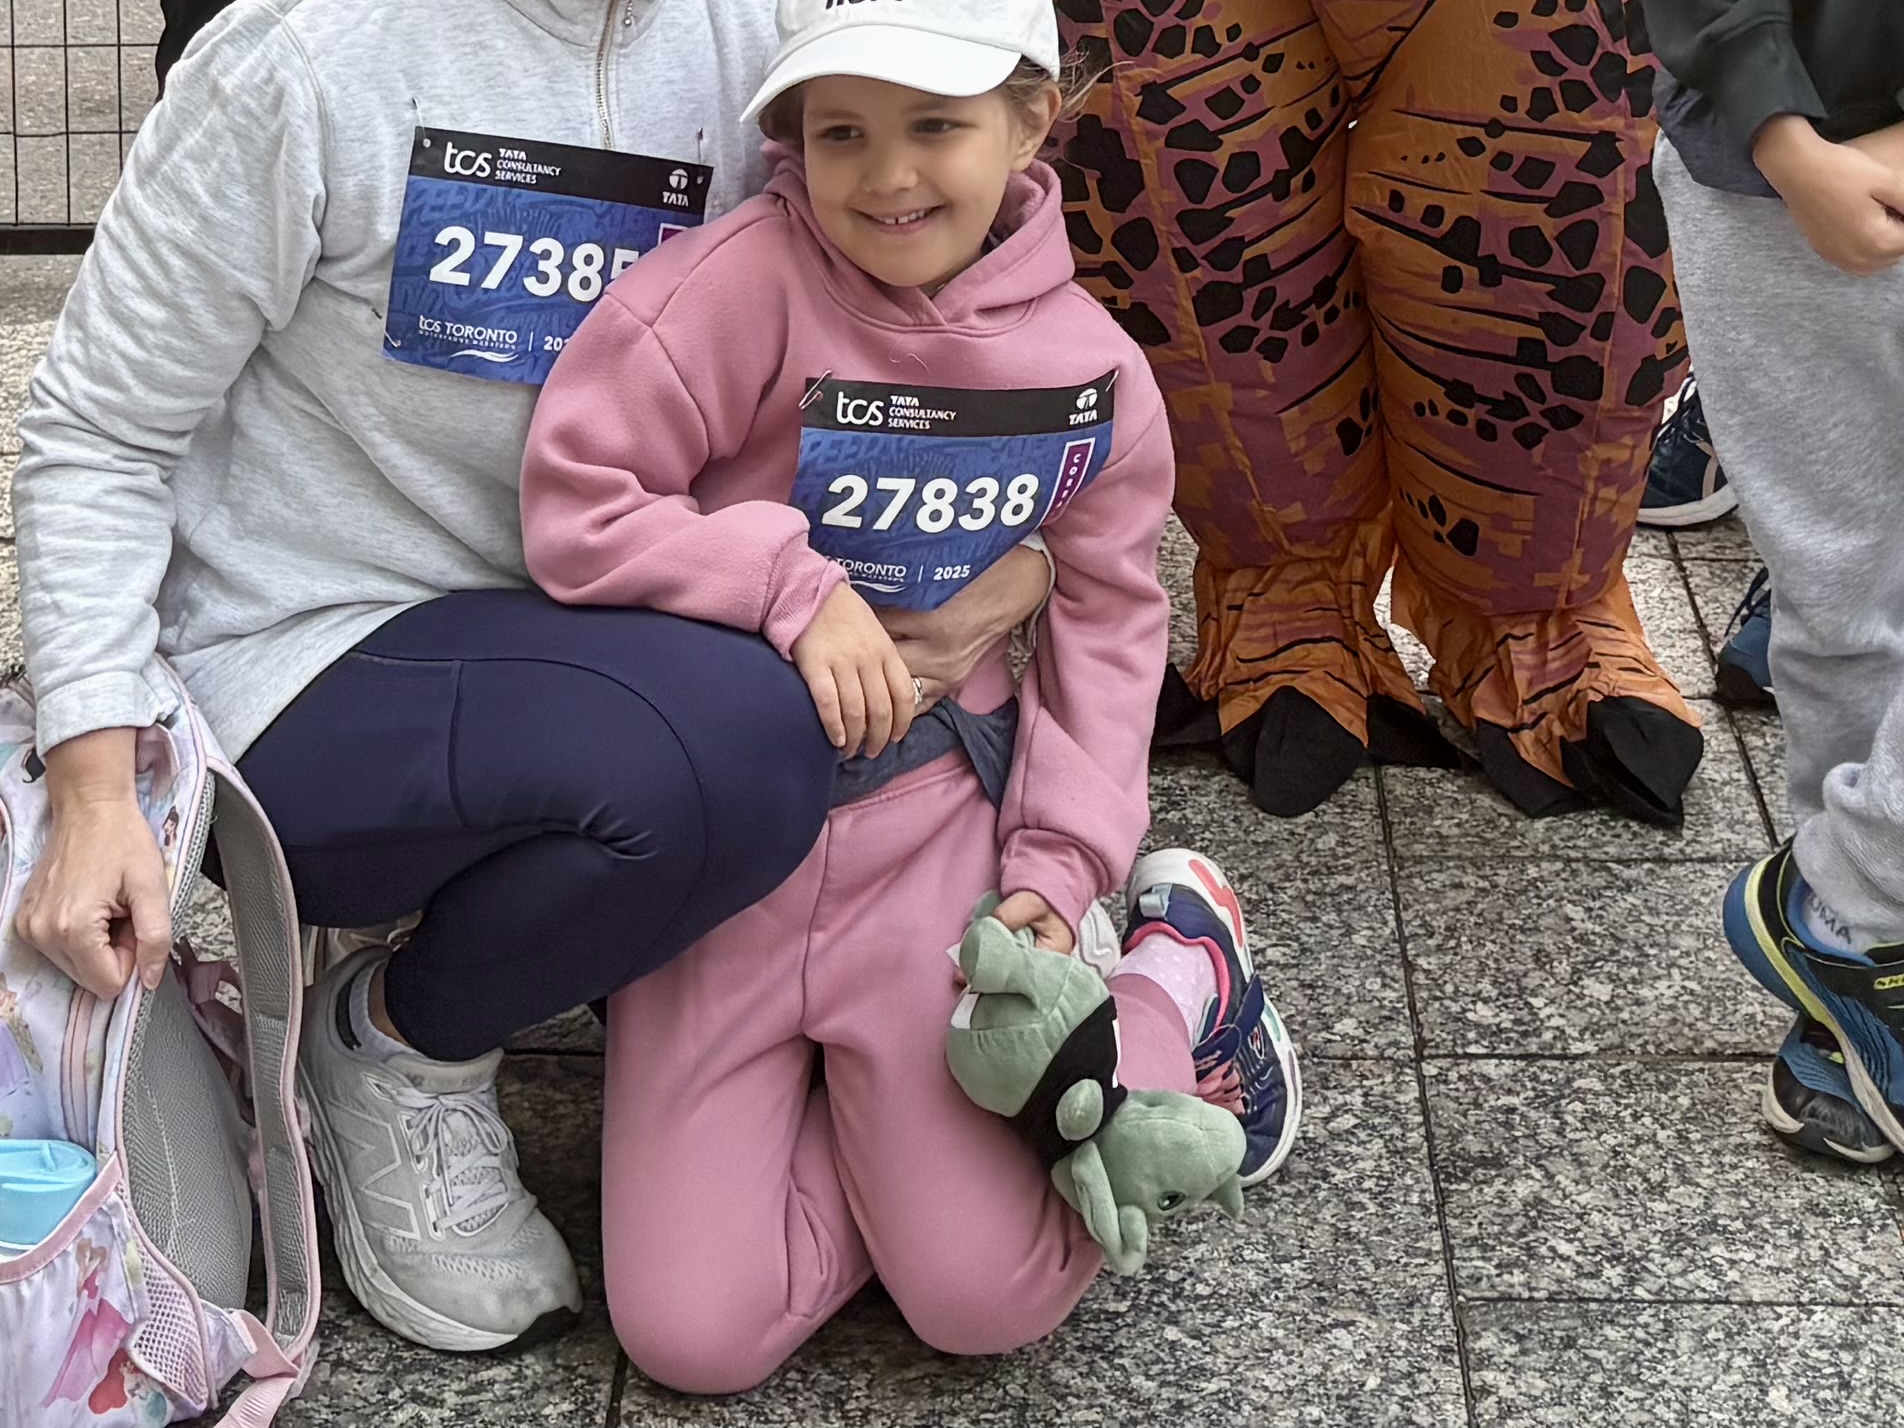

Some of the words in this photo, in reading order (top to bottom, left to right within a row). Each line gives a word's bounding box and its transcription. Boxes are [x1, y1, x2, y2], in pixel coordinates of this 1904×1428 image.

[443, 141, 493, 178] tcs
[498, 147, 527, 161] TATA
[495, 169, 538, 185] SERVICES
[662, 190, 690, 207] TATA
[418, 314, 441, 332] tcs
[444, 321, 518, 344] TORONTO
[836, 390, 885, 427] tcs
[890, 395, 920, 407] TATA
[888, 406, 957, 421] CONSULTANCY
[1068, 409, 1098, 426] TATA
[887, 417, 931, 430] SERVICES
[820, 473, 1040, 534] 27838
[837, 556, 907, 578] TORONTO
[933, 565, 972, 581] 2025
